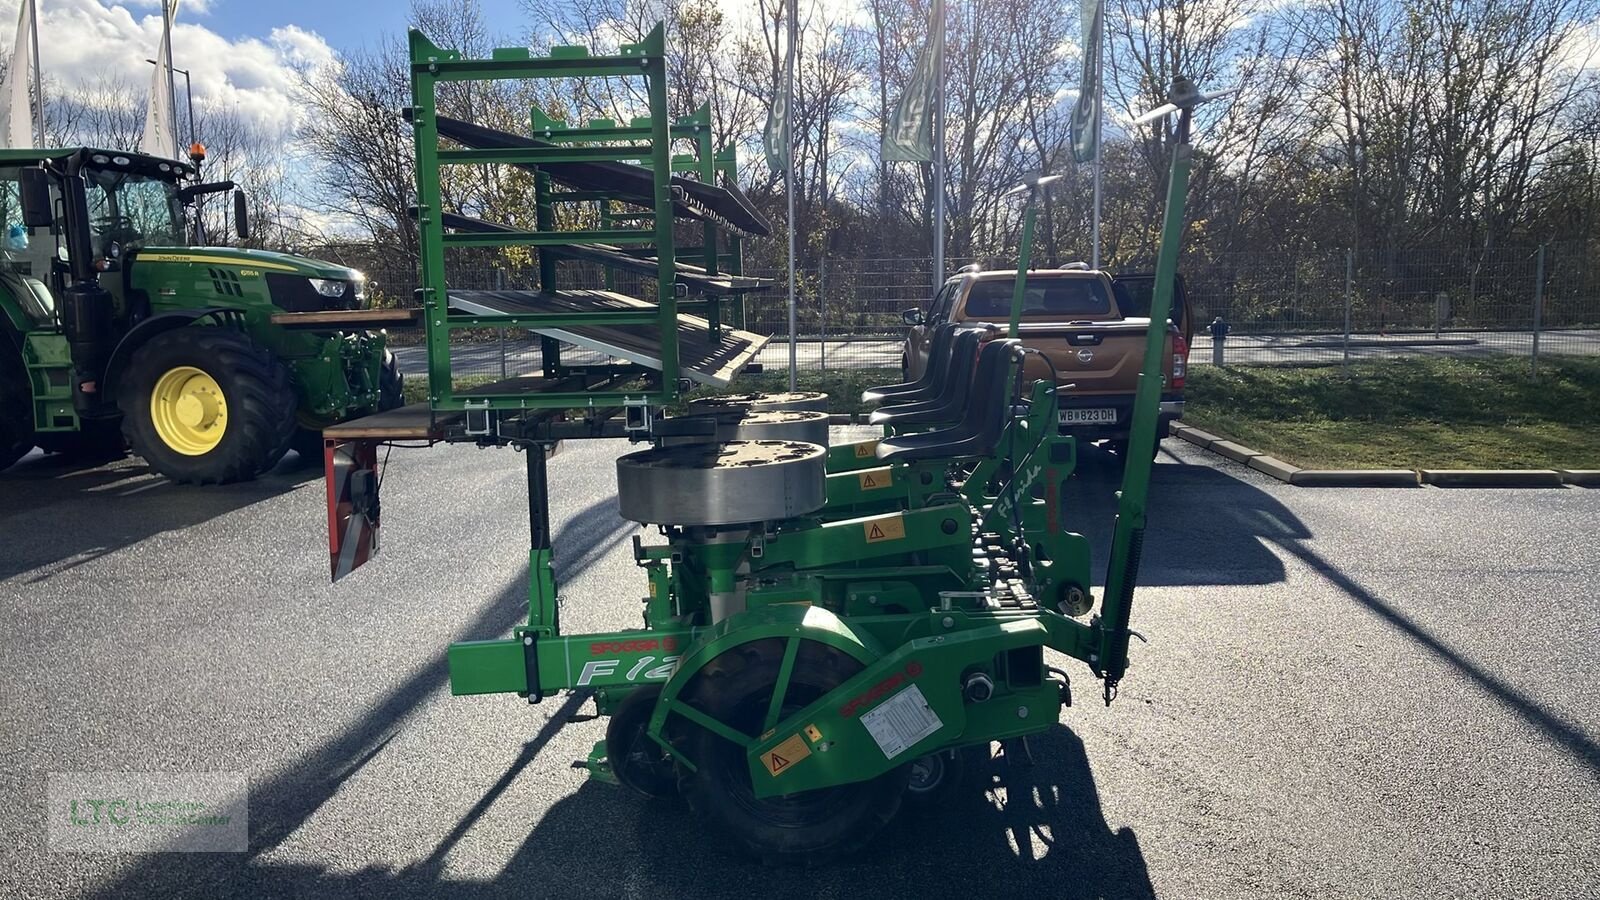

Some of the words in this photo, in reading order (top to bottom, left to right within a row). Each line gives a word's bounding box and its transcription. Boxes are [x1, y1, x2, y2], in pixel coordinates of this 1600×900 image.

[1060, 410, 1074, 421] WB
[1080, 410, 1100, 421] 823
[1101, 410, 1114, 420] DH
